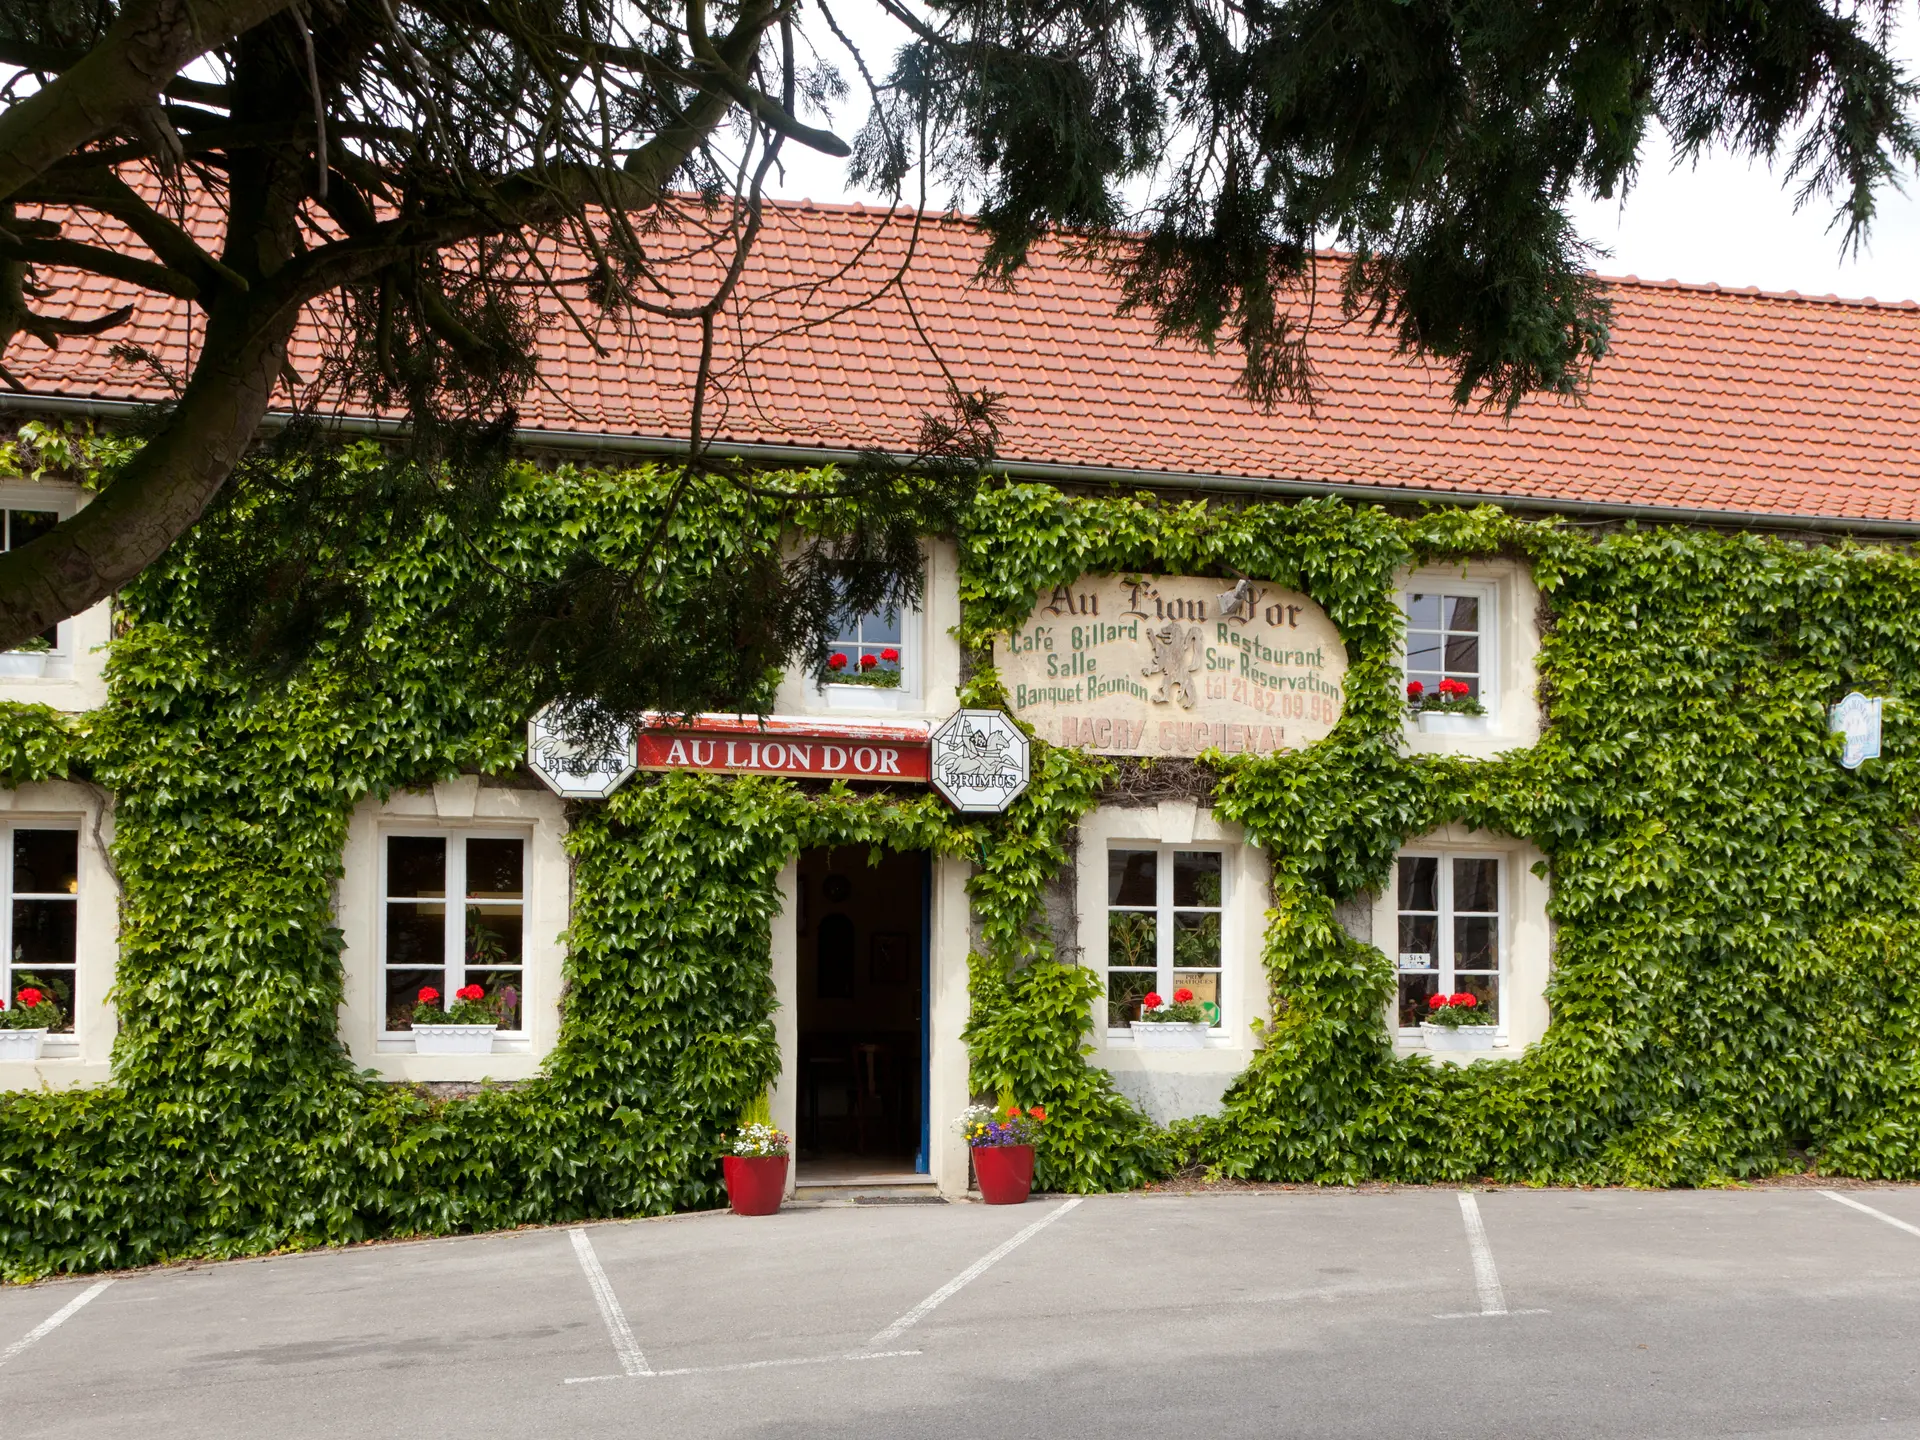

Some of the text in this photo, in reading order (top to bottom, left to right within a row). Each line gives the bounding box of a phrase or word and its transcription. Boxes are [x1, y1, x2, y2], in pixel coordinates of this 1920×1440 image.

[1041, 584, 1100, 620] Au
[1119, 580, 1208, 624] Lion
[1011, 620, 1138, 655] Café Billard
[1217, 622, 1325, 671] Restaurant
[1047, 652, 1097, 678] Salle
[1206, 647, 1340, 702] Sur Réservation
[1016, 673, 1149, 711] Banquet Réunion
[666, 739, 901, 774] AU LION D'OR
[946, 773, 1017, 789] PRIMUS
